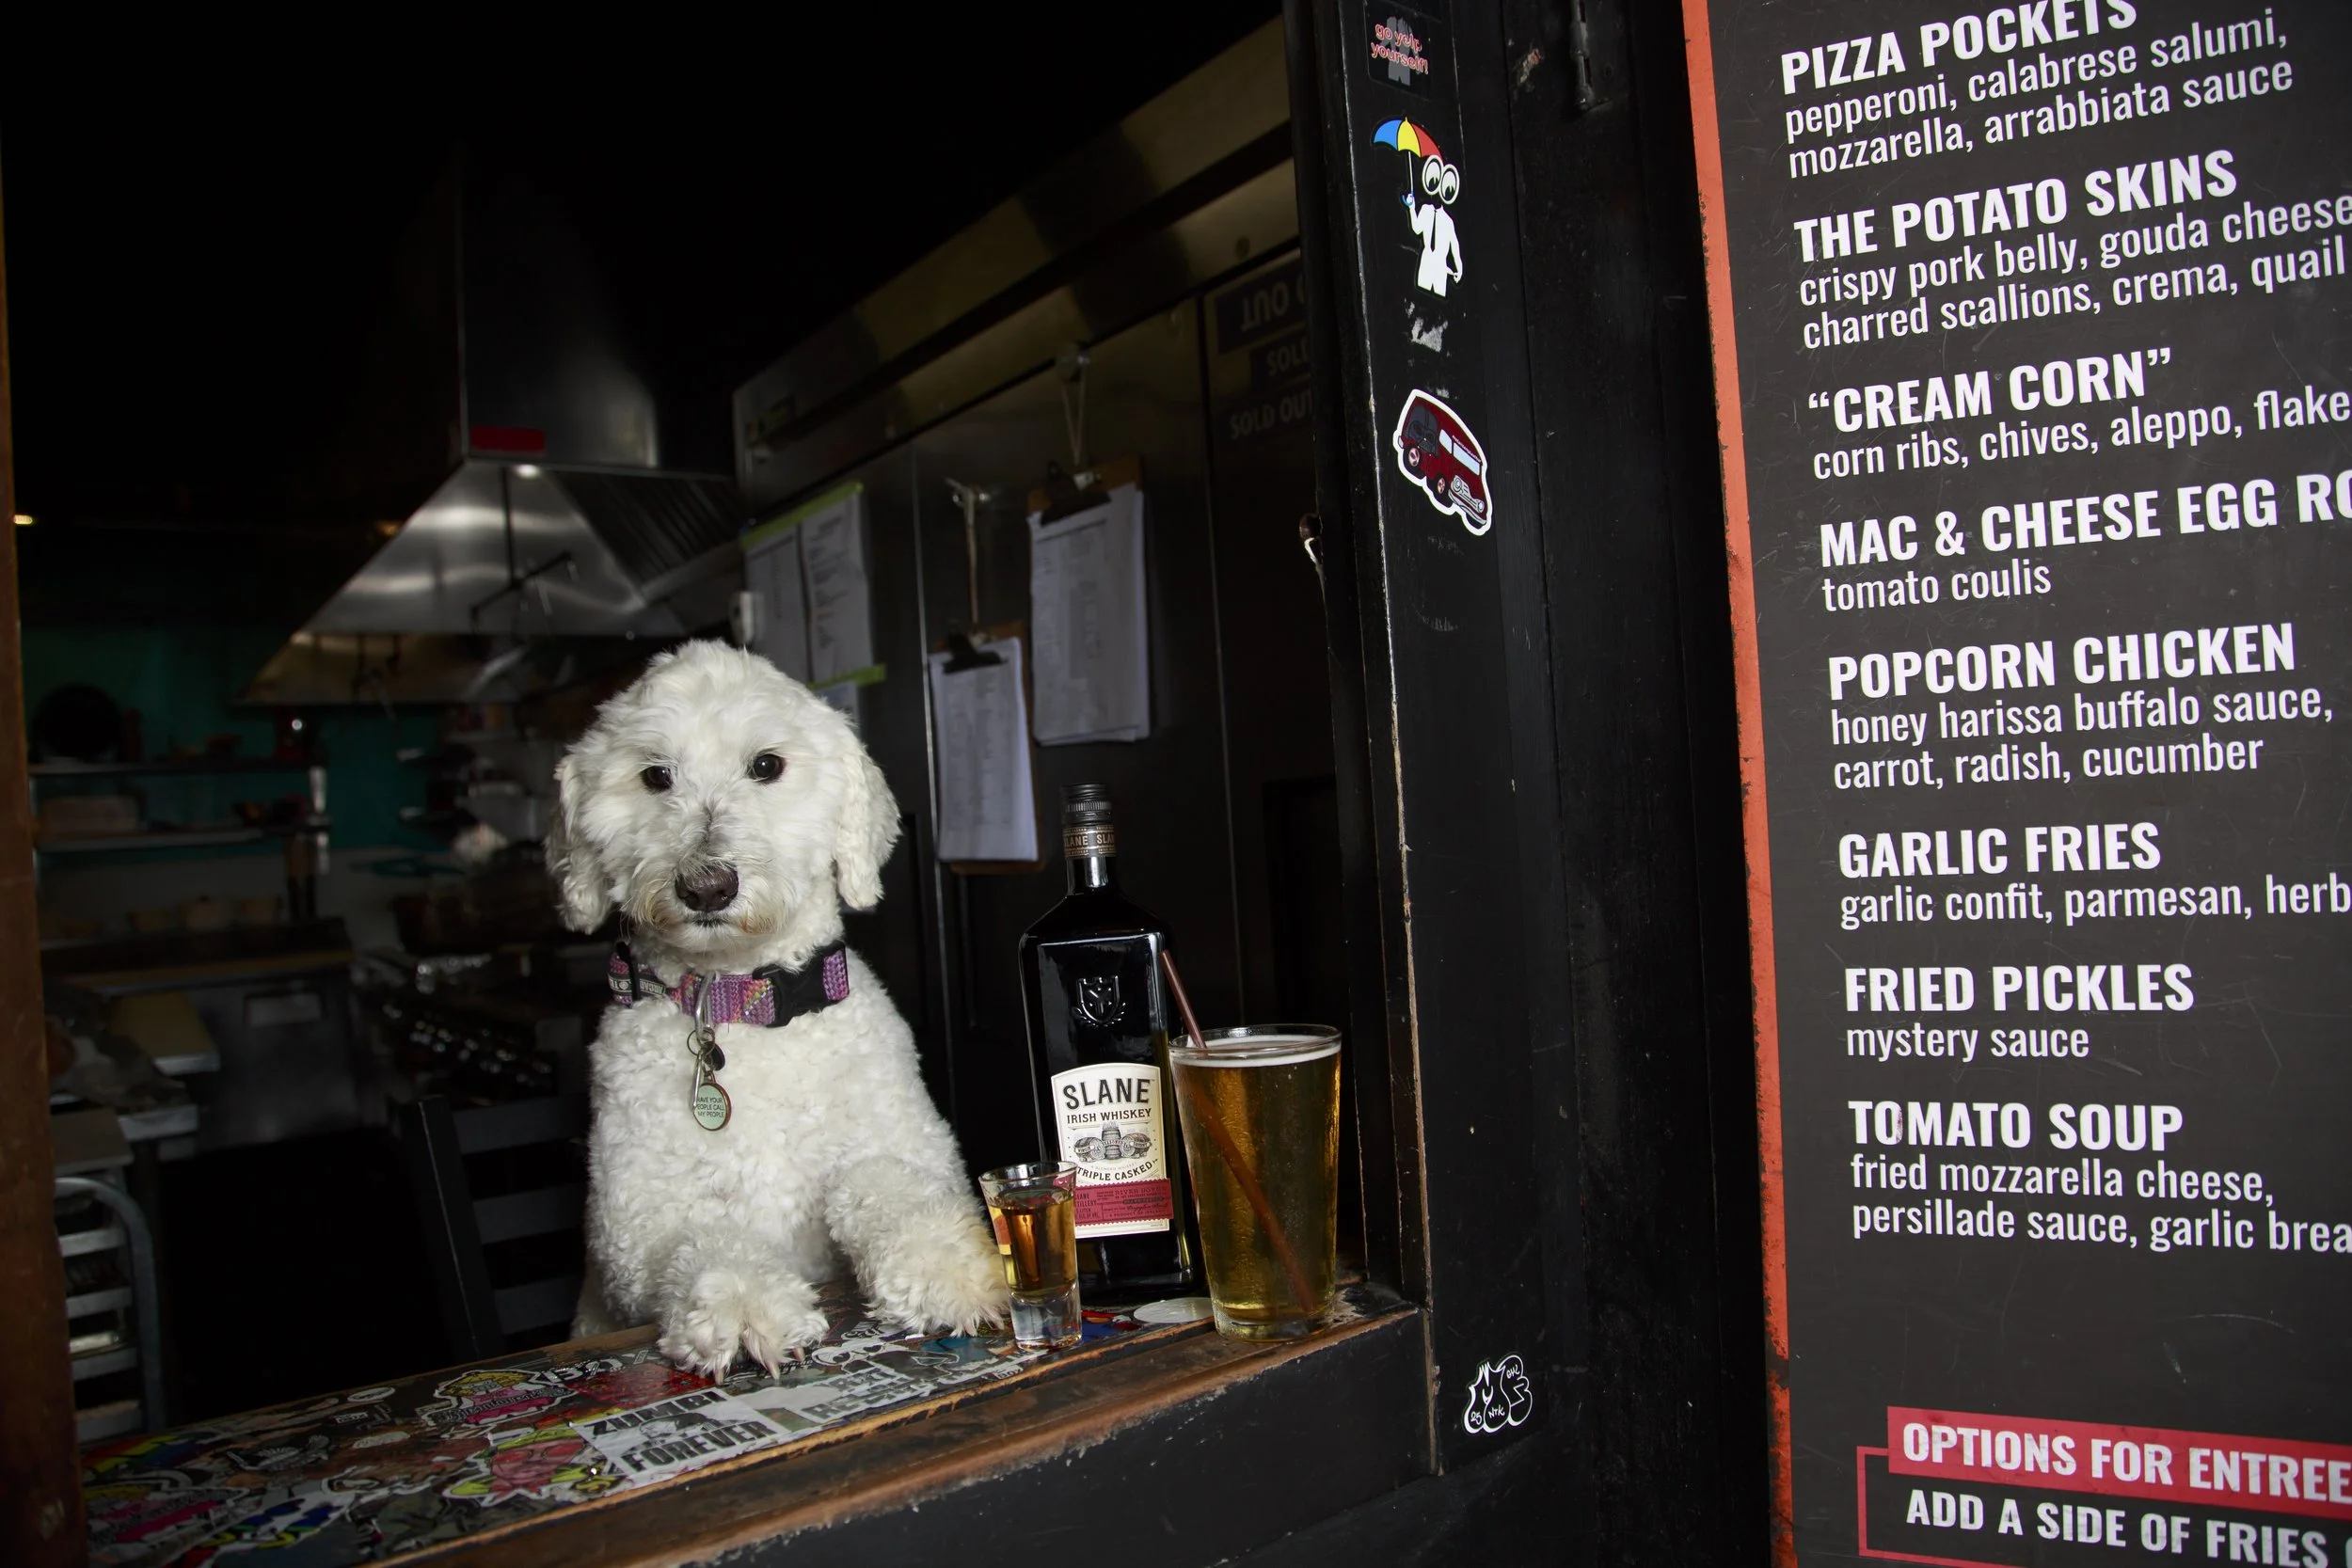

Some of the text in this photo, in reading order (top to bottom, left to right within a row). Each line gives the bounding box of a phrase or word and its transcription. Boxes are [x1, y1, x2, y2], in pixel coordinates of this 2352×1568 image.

[1370, 41, 1429, 75] yourself!
[1375, 24, 1422, 54] go yelp
[1781, 0, 2137, 95] PIZZA POCKETS
[1785, 8, 2286, 145] pepperoni, calabrese salumi,
[1788, 61, 2293, 179] mozzarella, arrabbiata sauce
[1793, 150, 2237, 263] THE POTATO SKINS
[1800, 195, 2352, 307] crispy pork belly, gouda cheese
[1803, 234, 2345, 349] charred scallions, crema, quail
[1230, 404, 1275, 441] SOLD
[1813, 385, 2351, 480] corn ribs, chives, aleppo, flake
[1820, 515, 1918, 568] MAC
[1934, 510, 1966, 557] &
[1980, 490, 2162, 552] CHEESE
[2176, 478, 2278, 534] EGG
[1820, 558, 2052, 612] tomato coulis
[1828, 622, 2295, 701] POPCORN CHICKEN
[1831, 686, 2332, 747] honey harissa buffalo sauce,
[1834, 732, 2265, 790] carrot, radish, cucumber
[1838, 821, 2161, 879] GARLIC FRIES
[1840, 872, 2351, 931] garlic confit, parmesan, herb
[1844, 963, 2195, 1012] FRIED PICKLES
[1847, 1022, 2090, 1063] mystery sauce
[1062, 1078, 1151, 1111] SLANE
[1067, 1108, 1152, 1124] IRISH WHISKEY
[1847, 1100, 2184, 1151] TOMATO SOUP
[1076, 1161, 1153, 1181] TRIPLE CASKED
[1850, 1152, 2273, 1208] fried mozzarella cheese,
[1852, 1197, 2352, 1254] persillade sauce, garlic brea
[583, 1390, 729, 1436] ZUMBI
[620, 1419, 778, 1473] FOREVER
[1902, 1422, 2352, 1504] OPTIONS FOR ENTREE
[1906, 1489, 1984, 1530] ADD
[1997, 1498, 2024, 1536] A
[2036, 1502, 2126, 1547] SIDE
[2140, 1513, 2190, 1554] OF
[2206, 1519, 2328, 1568] FRIES
